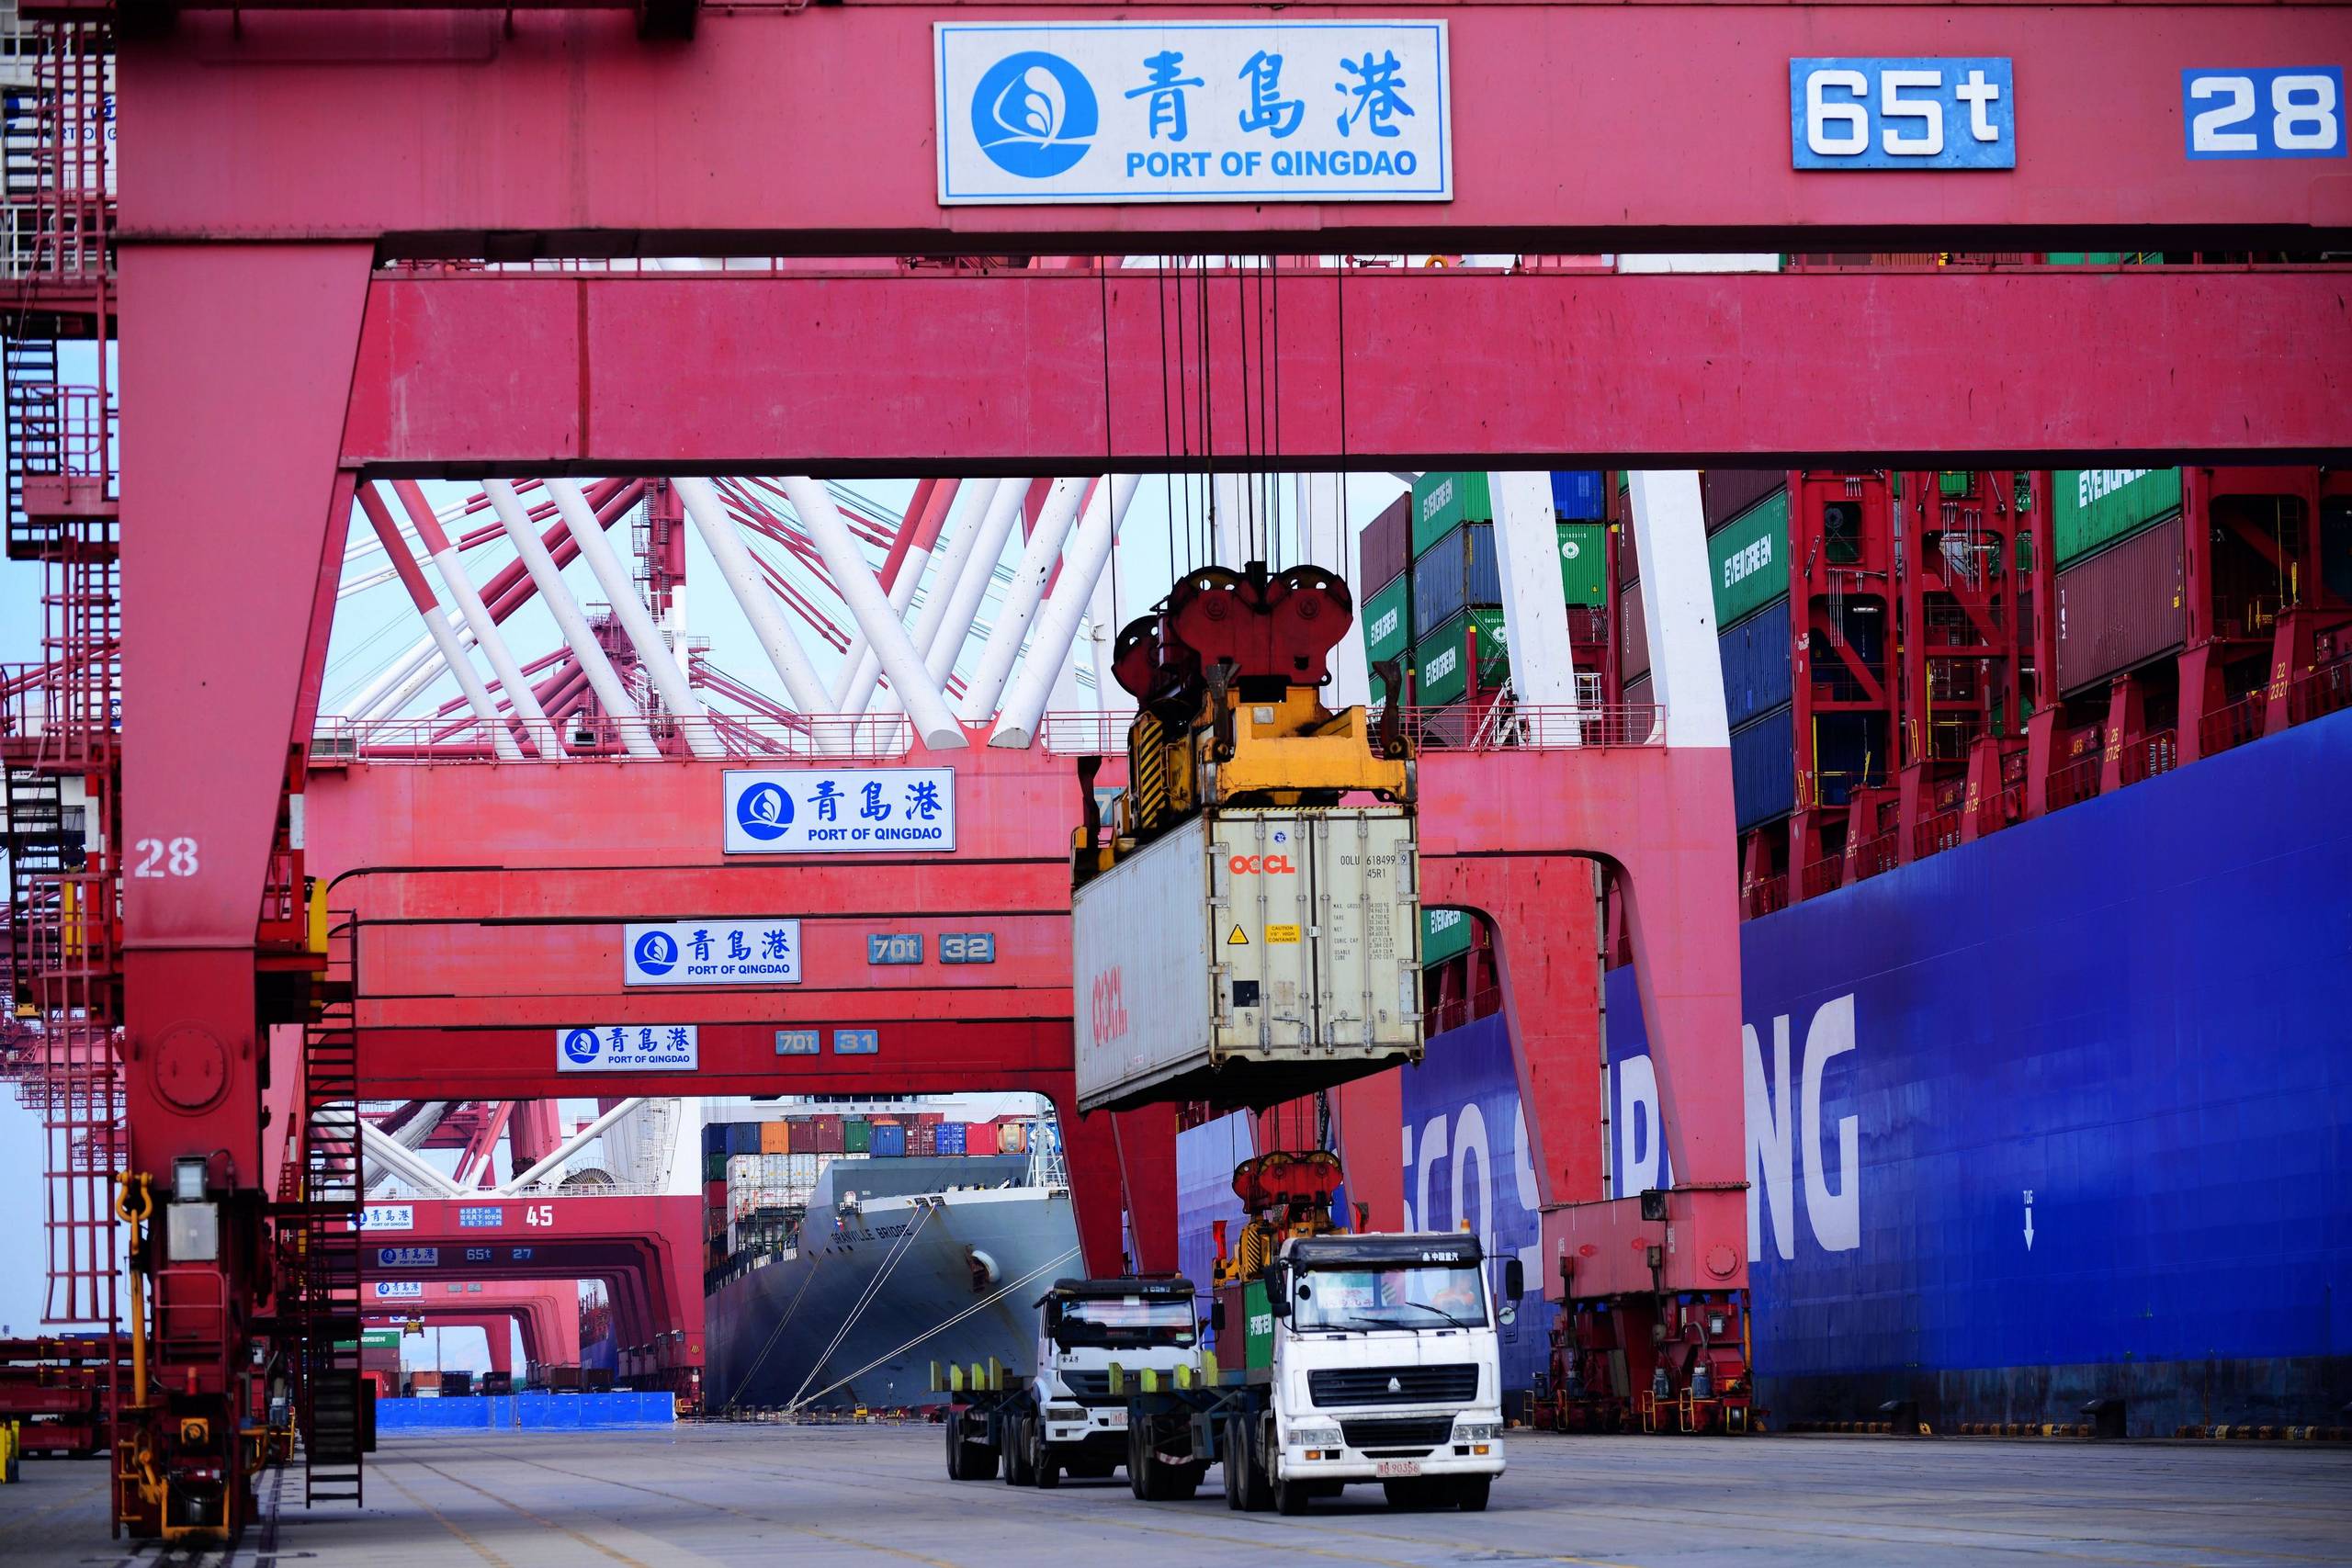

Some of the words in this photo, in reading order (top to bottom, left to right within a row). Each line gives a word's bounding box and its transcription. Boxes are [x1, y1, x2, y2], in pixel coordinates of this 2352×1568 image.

[1806, 70, 1999, 156] 65t
[2190, 75, 2338, 152] 28
[1126, 151, 1212, 178] PORT
[1220, 151, 1261, 177] OF
[1270, 150, 1418, 177] QINGDAO
[1724, 533, 1772, 589] EVERGREEN
[1426, 646, 1456, 687] EVERGREEN
[2276, 662, 2286, 679] 22
[808, 829, 846, 841] PORT
[851, 828, 871, 840] OF
[874, 827, 943, 840] QINGDAO
[134, 837, 198, 877] 28
[1229, 854, 1295, 874] OOCL
[1366, 855, 1396, 865] 618499
[1401, 855, 1407, 863] 9
[1367, 868, 1386, 878] 45R1
[874, 939, 917, 959] 70t
[945, 938, 989, 957] 32
[688, 965, 718, 975] PORT
[720, 964, 736, 974] OF
[738, 964, 790, 974] QINGDAO
[780, 1034, 814, 1050] 70t
[840, 1033, 873, 1052] 31
[608, 1055, 632, 1064] PORT
[649, 1055, 690, 1063] QINGDAO
[2023, 1190, 2033, 1204] TUG
[526, 1205, 553, 1226] 45
[876, 1224, 913, 1240] BRIDGE
[466, 1248, 493, 1260] 65t
[513, 1248, 532, 1259] 27
